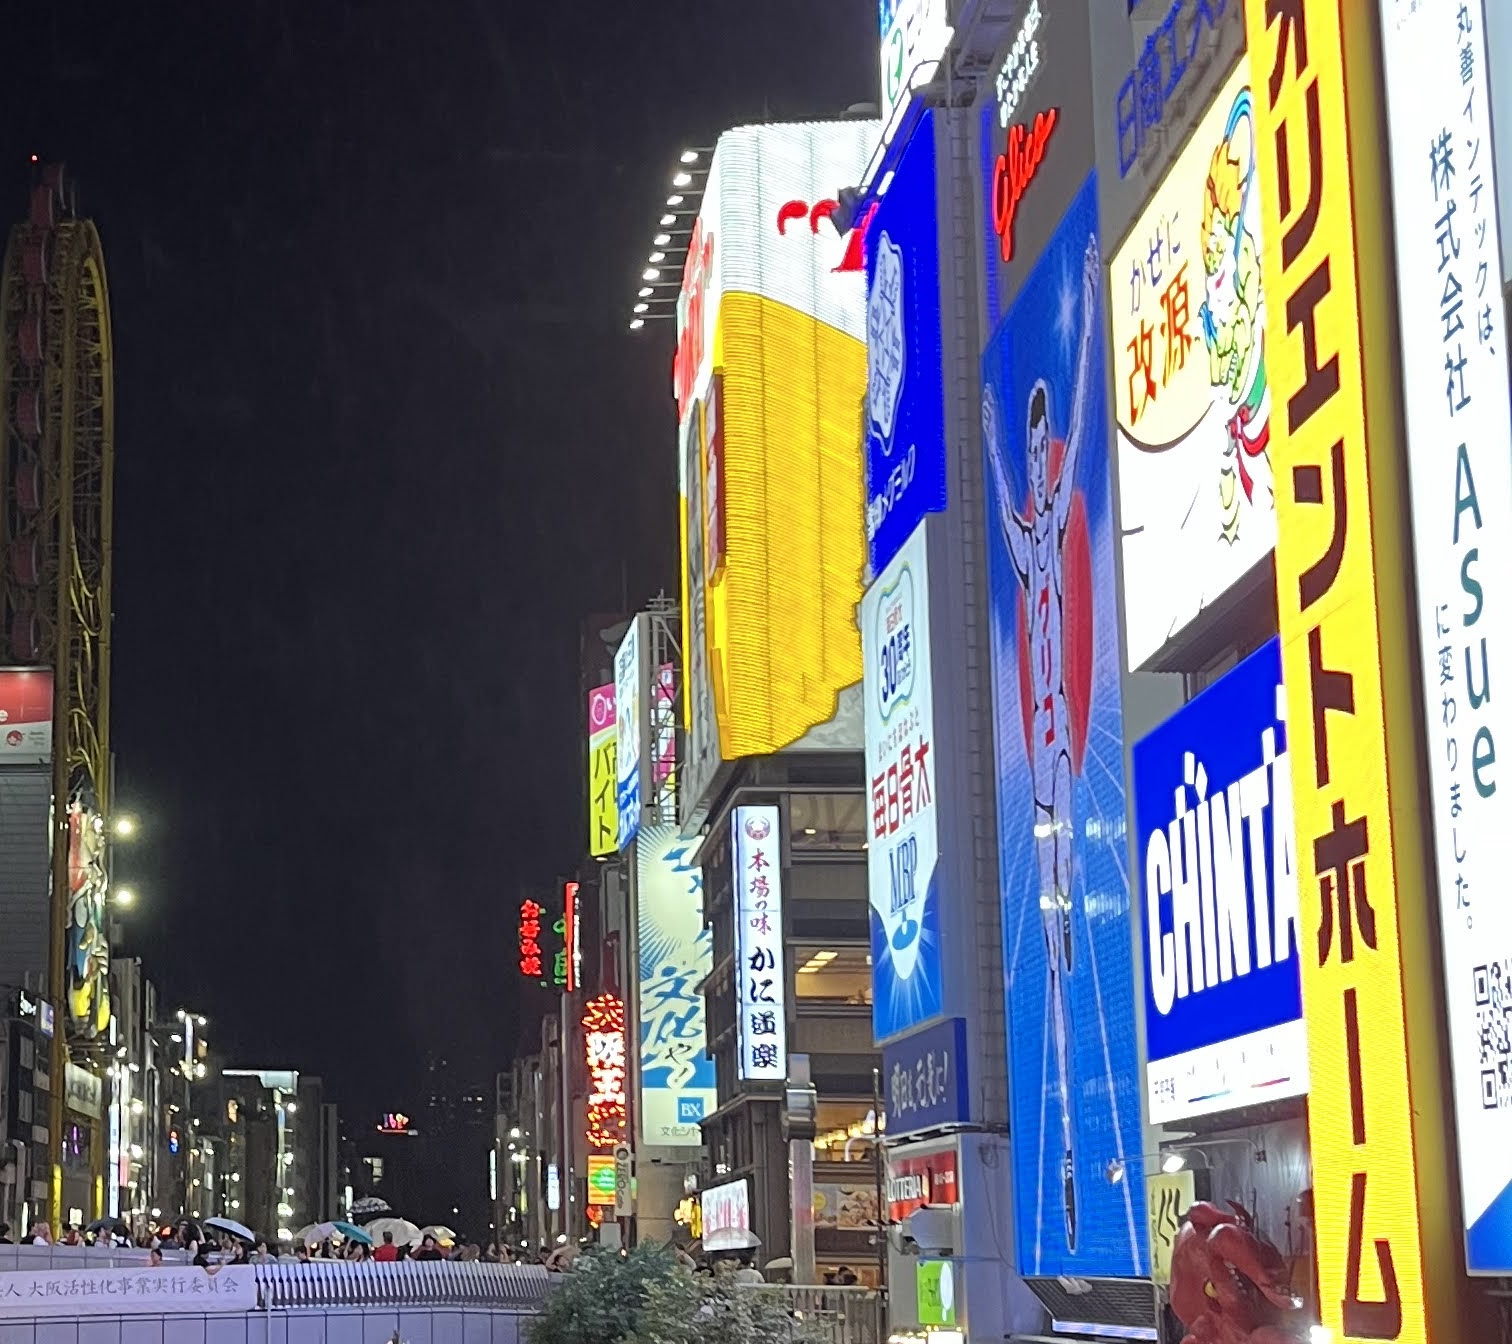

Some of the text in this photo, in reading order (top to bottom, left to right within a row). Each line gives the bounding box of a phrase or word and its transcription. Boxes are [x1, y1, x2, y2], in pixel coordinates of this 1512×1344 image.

[1130, 208, 1182, 317] かぜに
[1428, 125, 1473, 418] 株式会社
[1126, 260, 1194, 429] 改源
[1033, 574, 1056, 748] グリコ
[594, 741, 612, 849] バイト
[872, 735, 931, 838] 毎日骨太
[1436, 604, 1476, 932] に変わりました。
[747, 848, 772, 937] 本場の味
[889, 832, 918, 912] MBP
[746, 944, 782, 1070] かに道楽
[681, 1103, 701, 1116] BX
